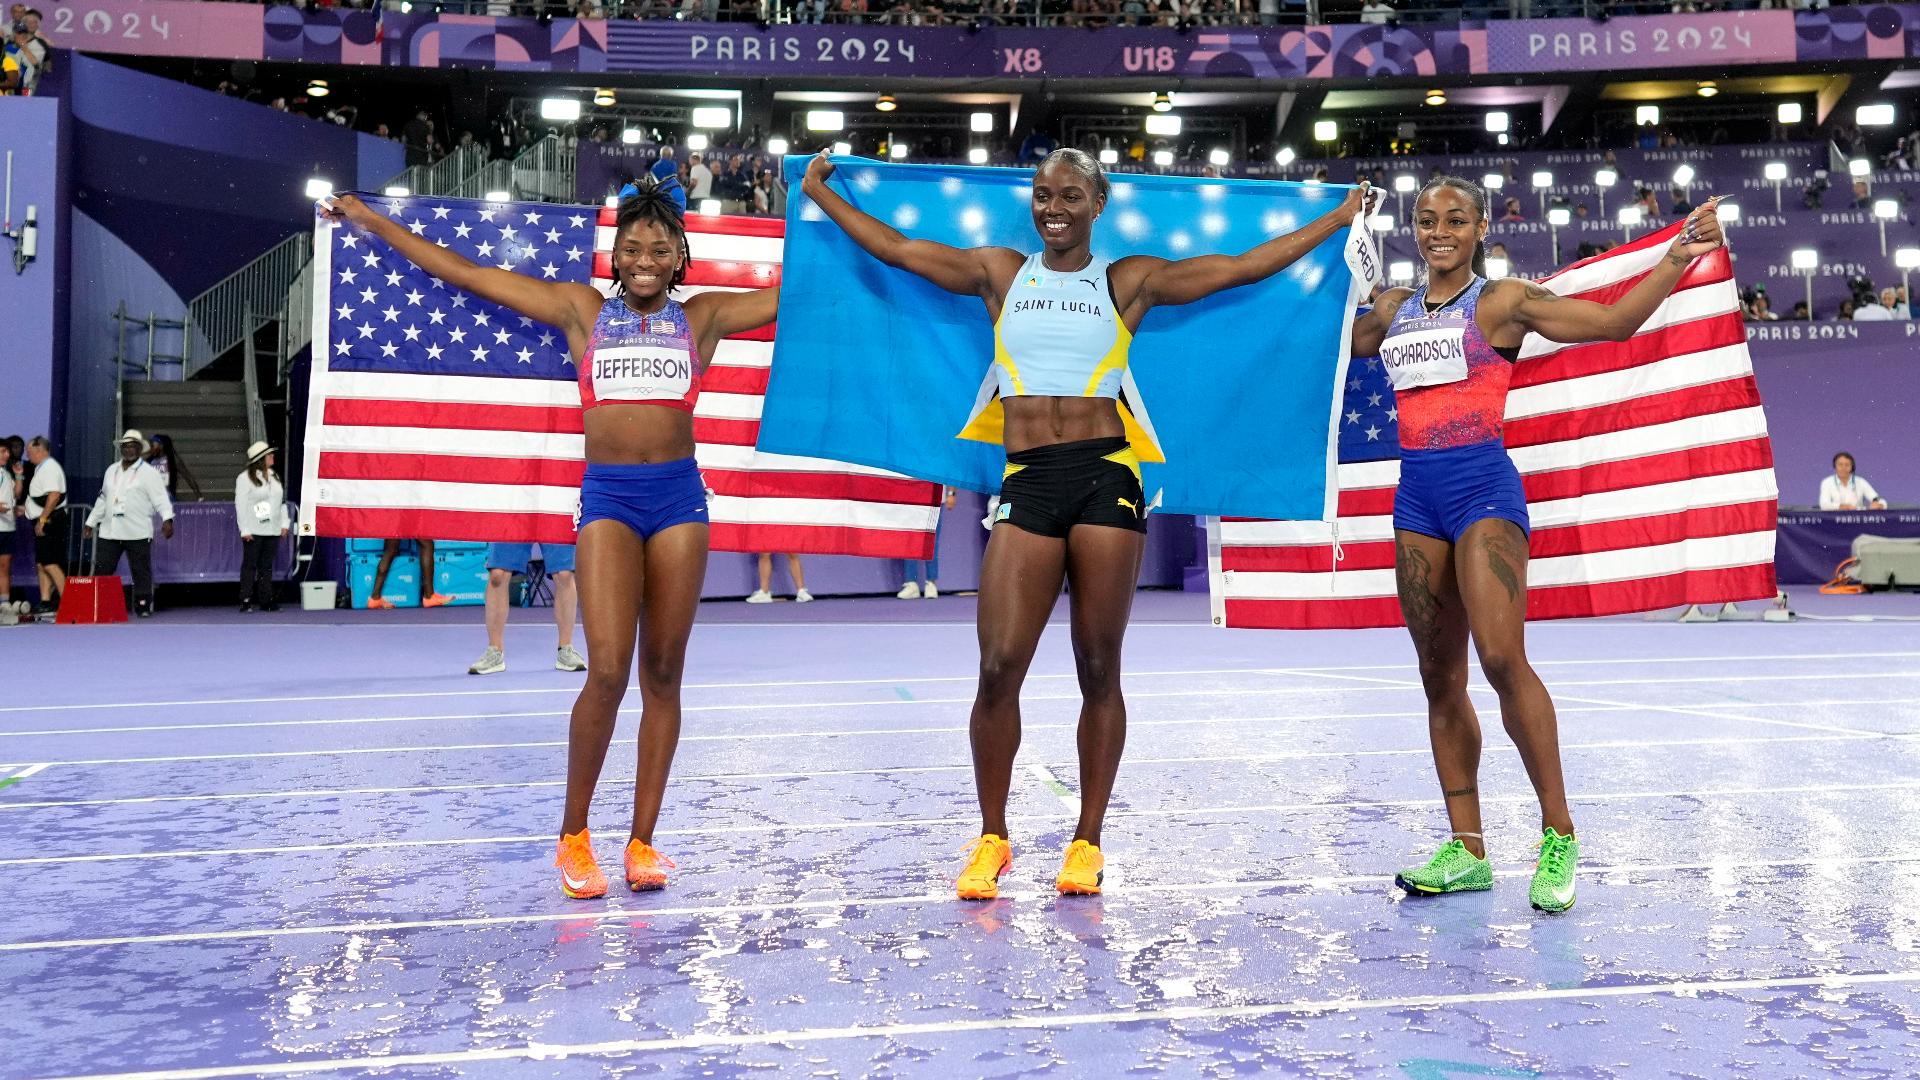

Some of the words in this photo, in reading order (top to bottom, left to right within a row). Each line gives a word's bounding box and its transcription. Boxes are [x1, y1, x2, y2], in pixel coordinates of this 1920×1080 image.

[54, 7, 170, 41] 2024
[691, 35, 801, 61] PARIS
[817, 37, 915, 63] 2024
[1529, 30, 1638, 57] PARIS
[1653, 25, 1751, 52] 2024
[1004, 48, 1042, 73] X8
[1123, 46, 1175, 72] U18
[1644, 152, 1677, 161] PARIS
[1741, 149, 1776, 158] PARIS
[1822, 212, 1865, 225] PARIS
[1822, 263, 1867, 276] 2024
[1014, 299, 1054, 313] SAINT
[1061, 300, 1102, 317] LUCIA
[1400, 322, 1419, 332] PARIS
[1420, 321, 1442, 329] 2024
[1747, 325, 1801, 341] PARIS
[1807, 324, 1859, 340] 2024
[619, 337, 643, 345] PARIS
[1382, 338, 1461, 368] RICHARDSON
[595, 358, 689, 380] JEFFERSON
